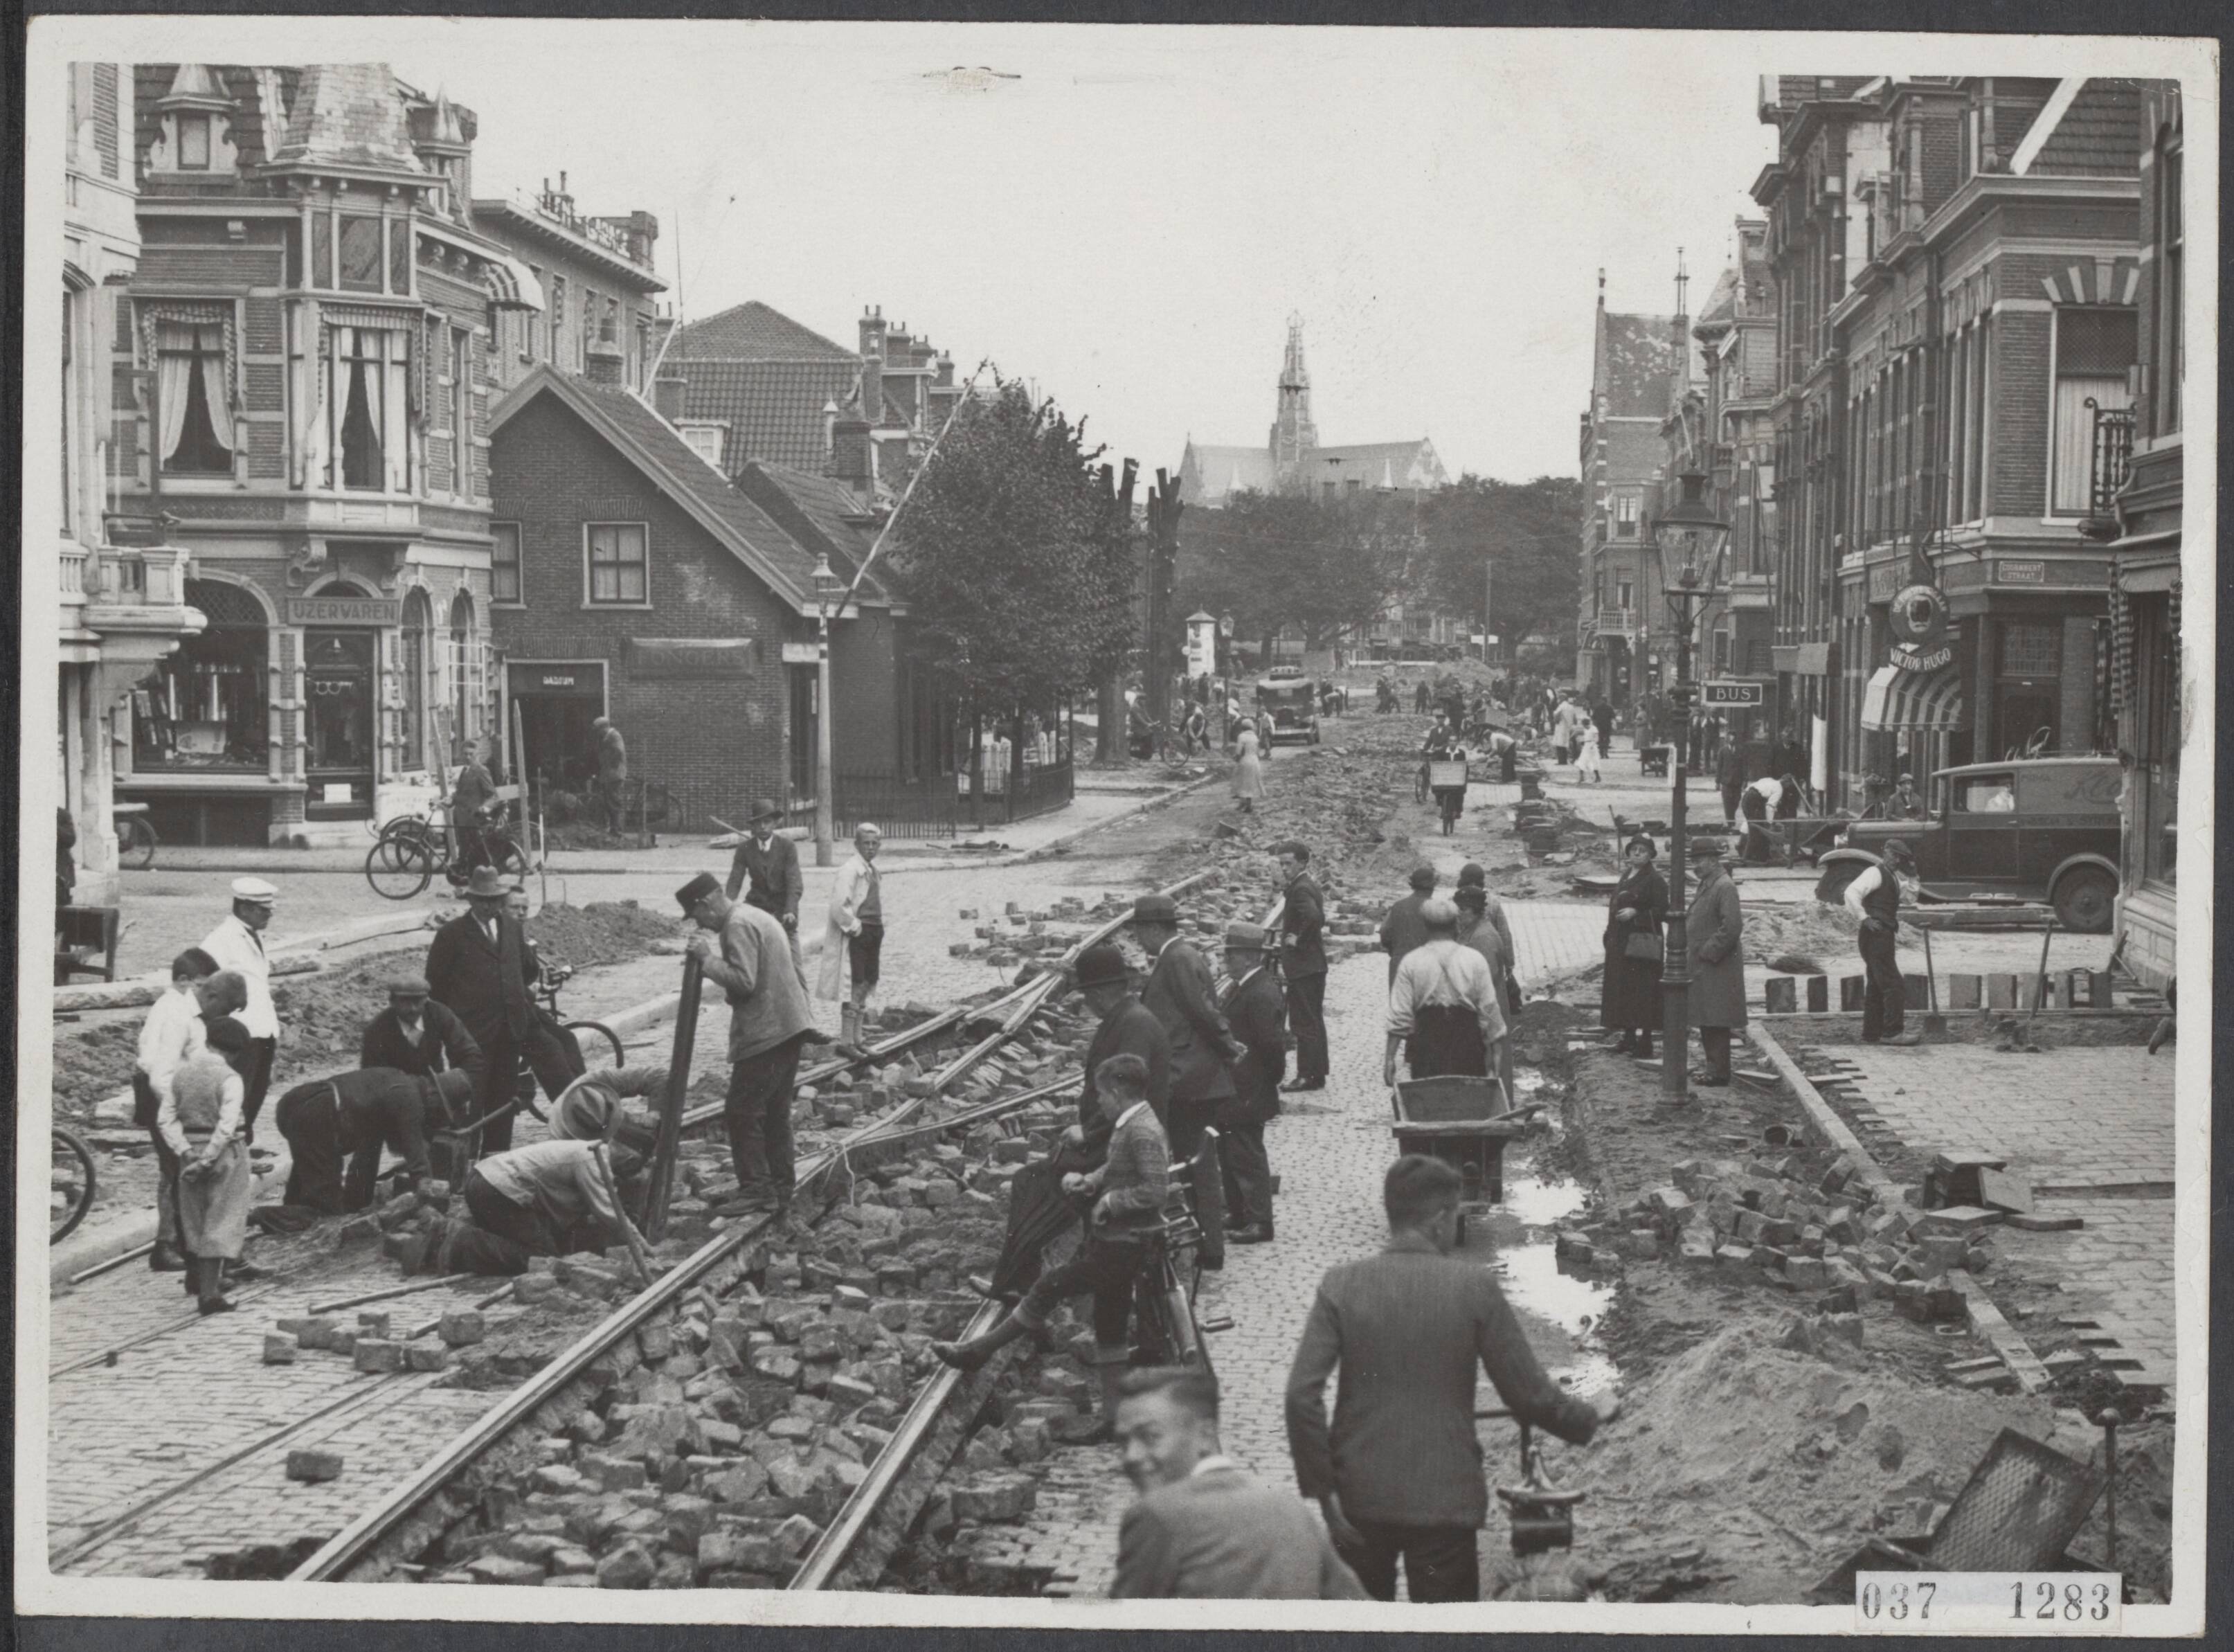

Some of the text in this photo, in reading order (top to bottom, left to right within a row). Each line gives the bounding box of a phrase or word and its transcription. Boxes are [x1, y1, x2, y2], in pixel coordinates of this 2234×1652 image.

[2008, 572, 2035, 580] STRAAT
[1890, 647, 1951, 671] VICTOR HUGO
[1716, 688, 1751, 701] BUS
